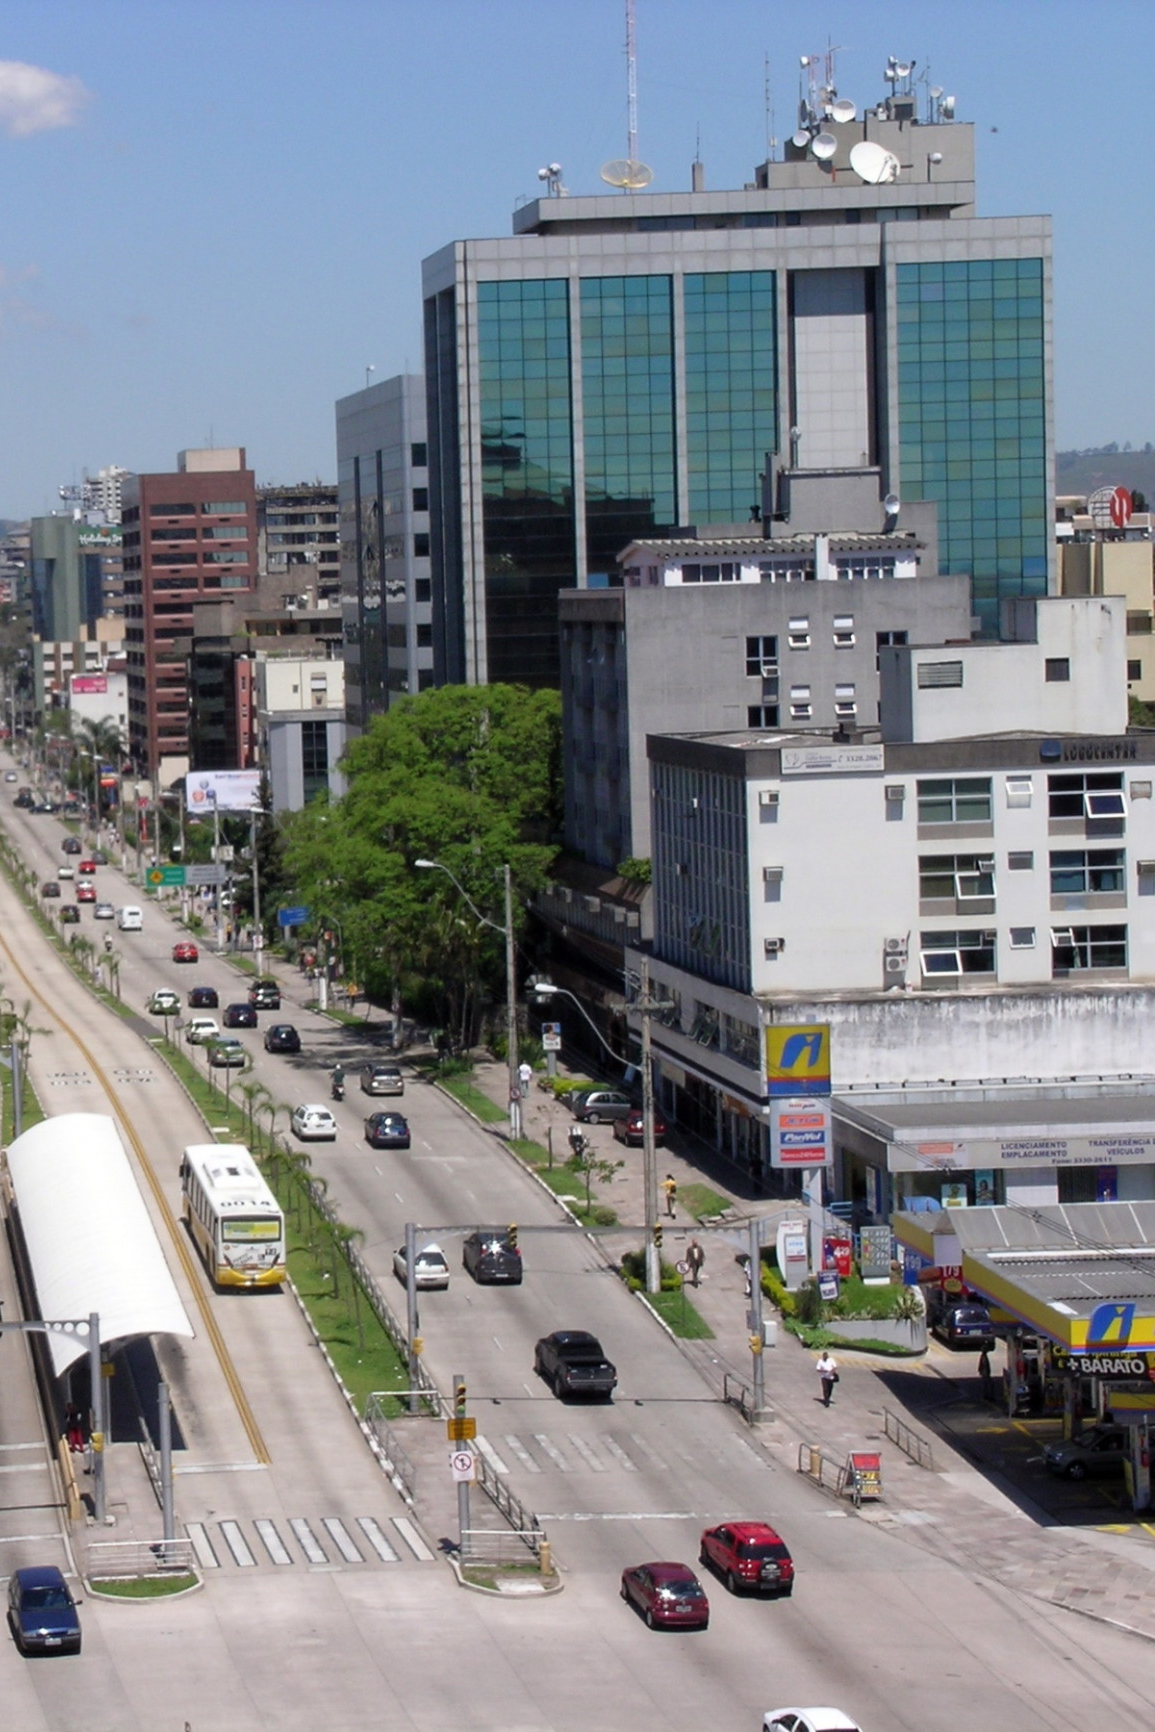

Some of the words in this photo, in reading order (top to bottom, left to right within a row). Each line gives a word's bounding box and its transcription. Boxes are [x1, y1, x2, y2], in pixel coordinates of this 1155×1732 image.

[1001, 1141, 1068, 1150] LICENCIAMENTO
[1088, 1138, 1151, 1147] TRANSFERÊNCIA
[1001, 1149, 1068, 1159] EMPLACAMENTO
[1106, 1147, 1145, 1156] VEÍCULOS
[1080, 1359, 1145, 1374] BARATO
